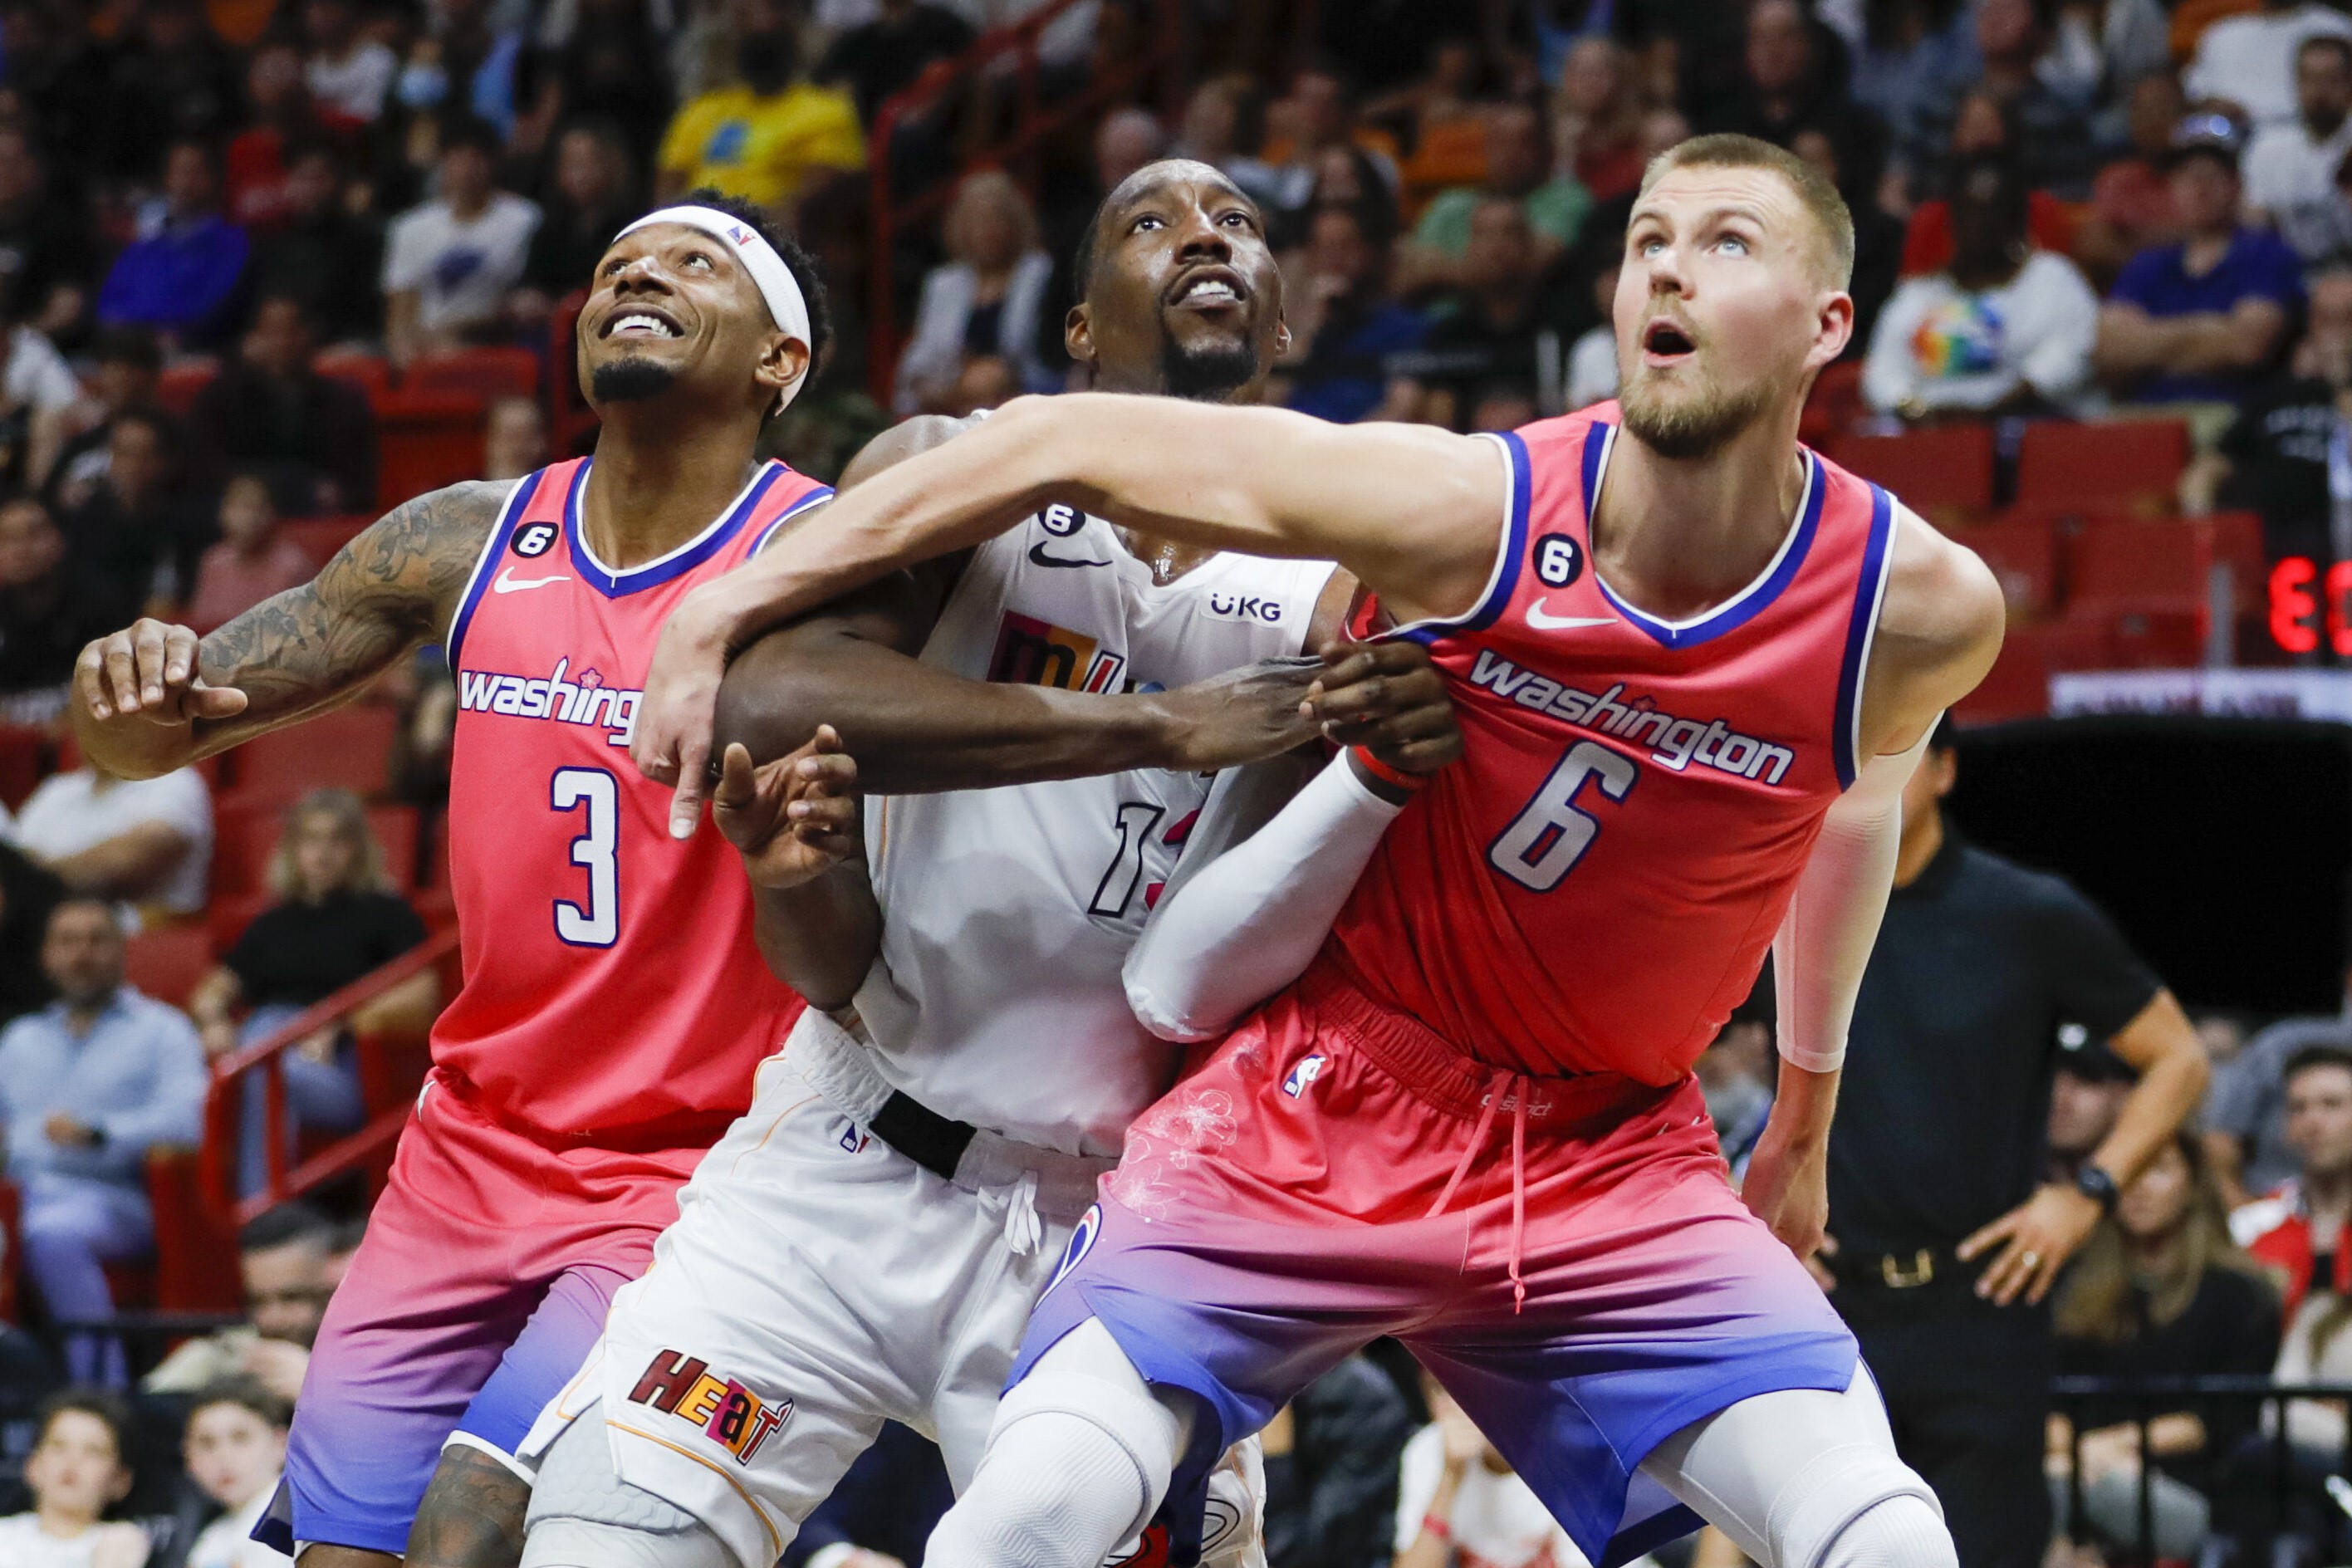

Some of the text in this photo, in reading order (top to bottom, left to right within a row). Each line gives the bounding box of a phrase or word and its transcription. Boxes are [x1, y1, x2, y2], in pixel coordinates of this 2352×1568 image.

[1045, 503, 1074, 533] 6
[518, 527, 553, 555] 6
[1541, 540, 1573, 583] 6
[1485, 737, 1641, 894] 6
[550, 765, 620, 949] 3
